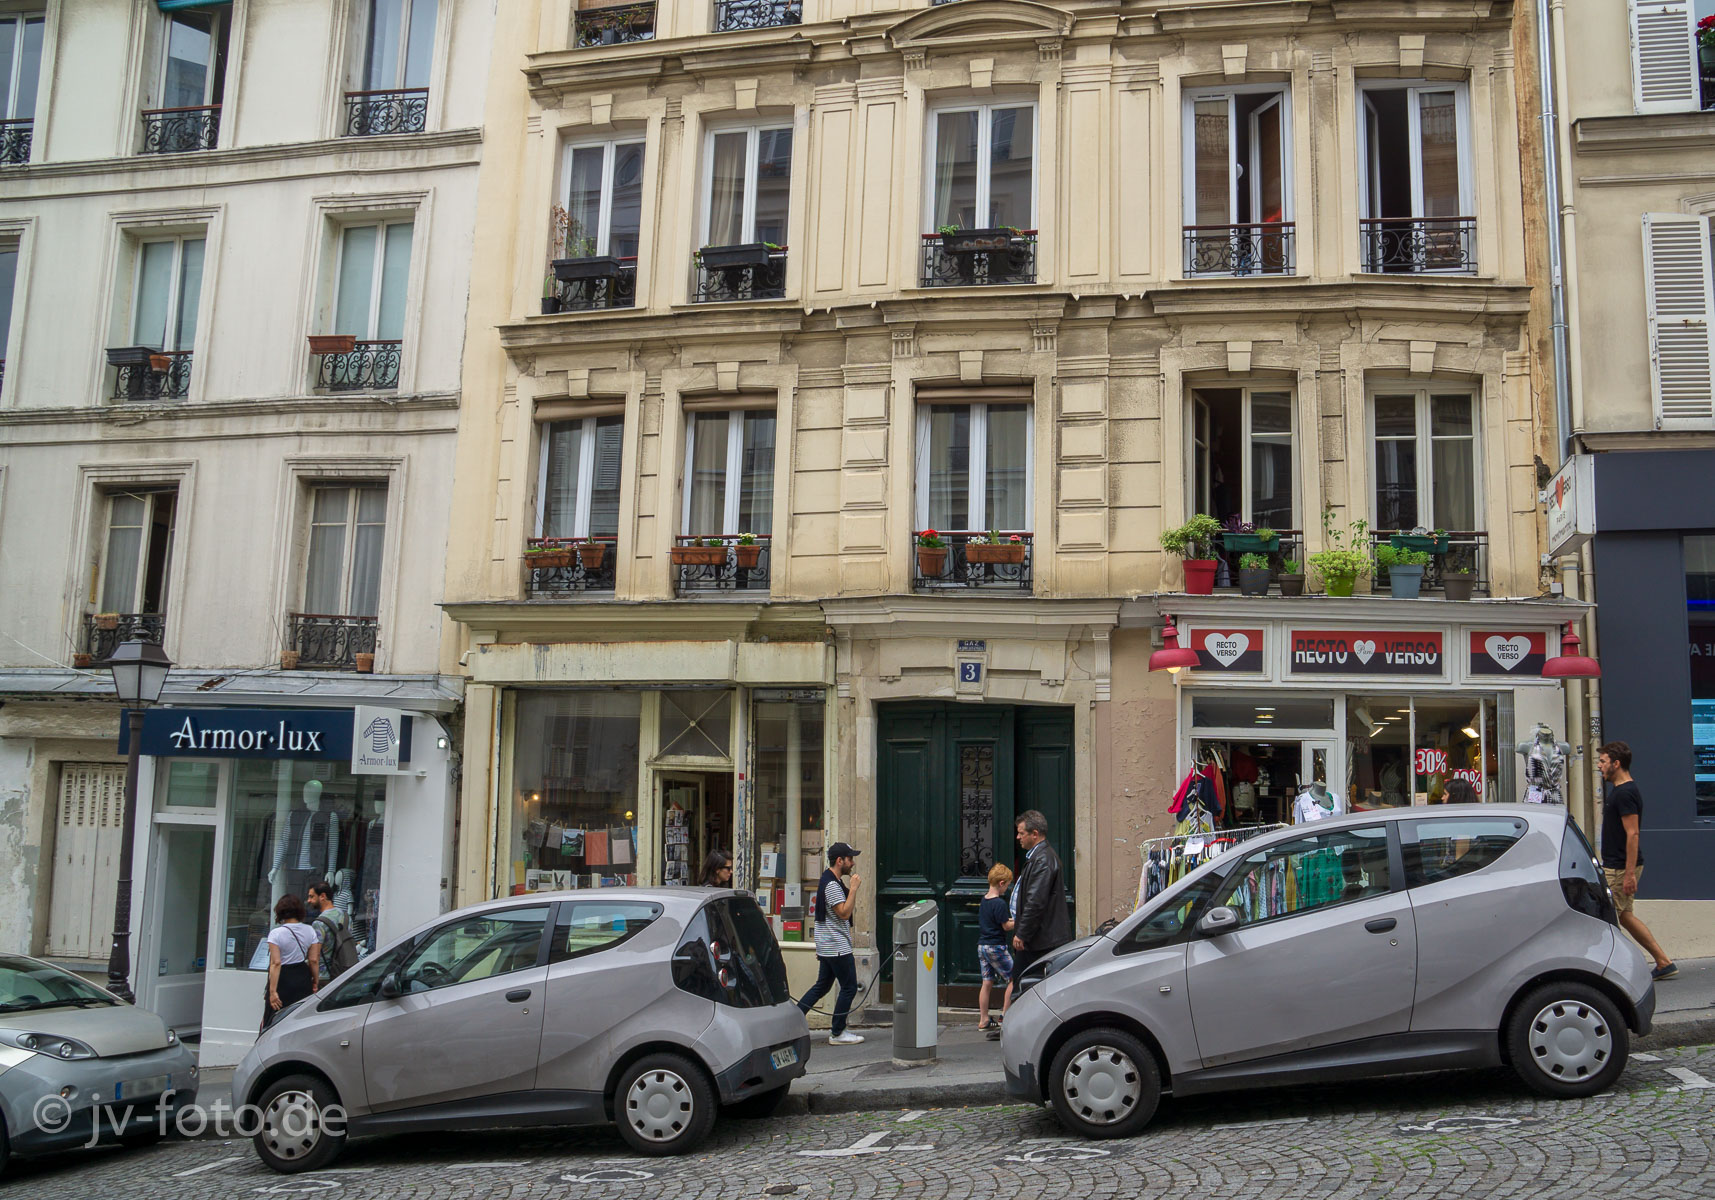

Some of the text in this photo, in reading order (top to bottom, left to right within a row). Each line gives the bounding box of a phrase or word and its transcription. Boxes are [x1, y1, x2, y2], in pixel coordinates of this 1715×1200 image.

[1216, 641, 1237, 649] RECTO
[1497, 644, 1519, 652] RECTO
[1216, 649, 1237, 657] VERSO
[1295, 639, 1348, 664] RECTO
[1384, 641, 1437, 665] VERSO
[1497, 652, 1519, 660] VERSO
[965, 663, 976, 681] 3
[920, 930, 936, 947] 03
